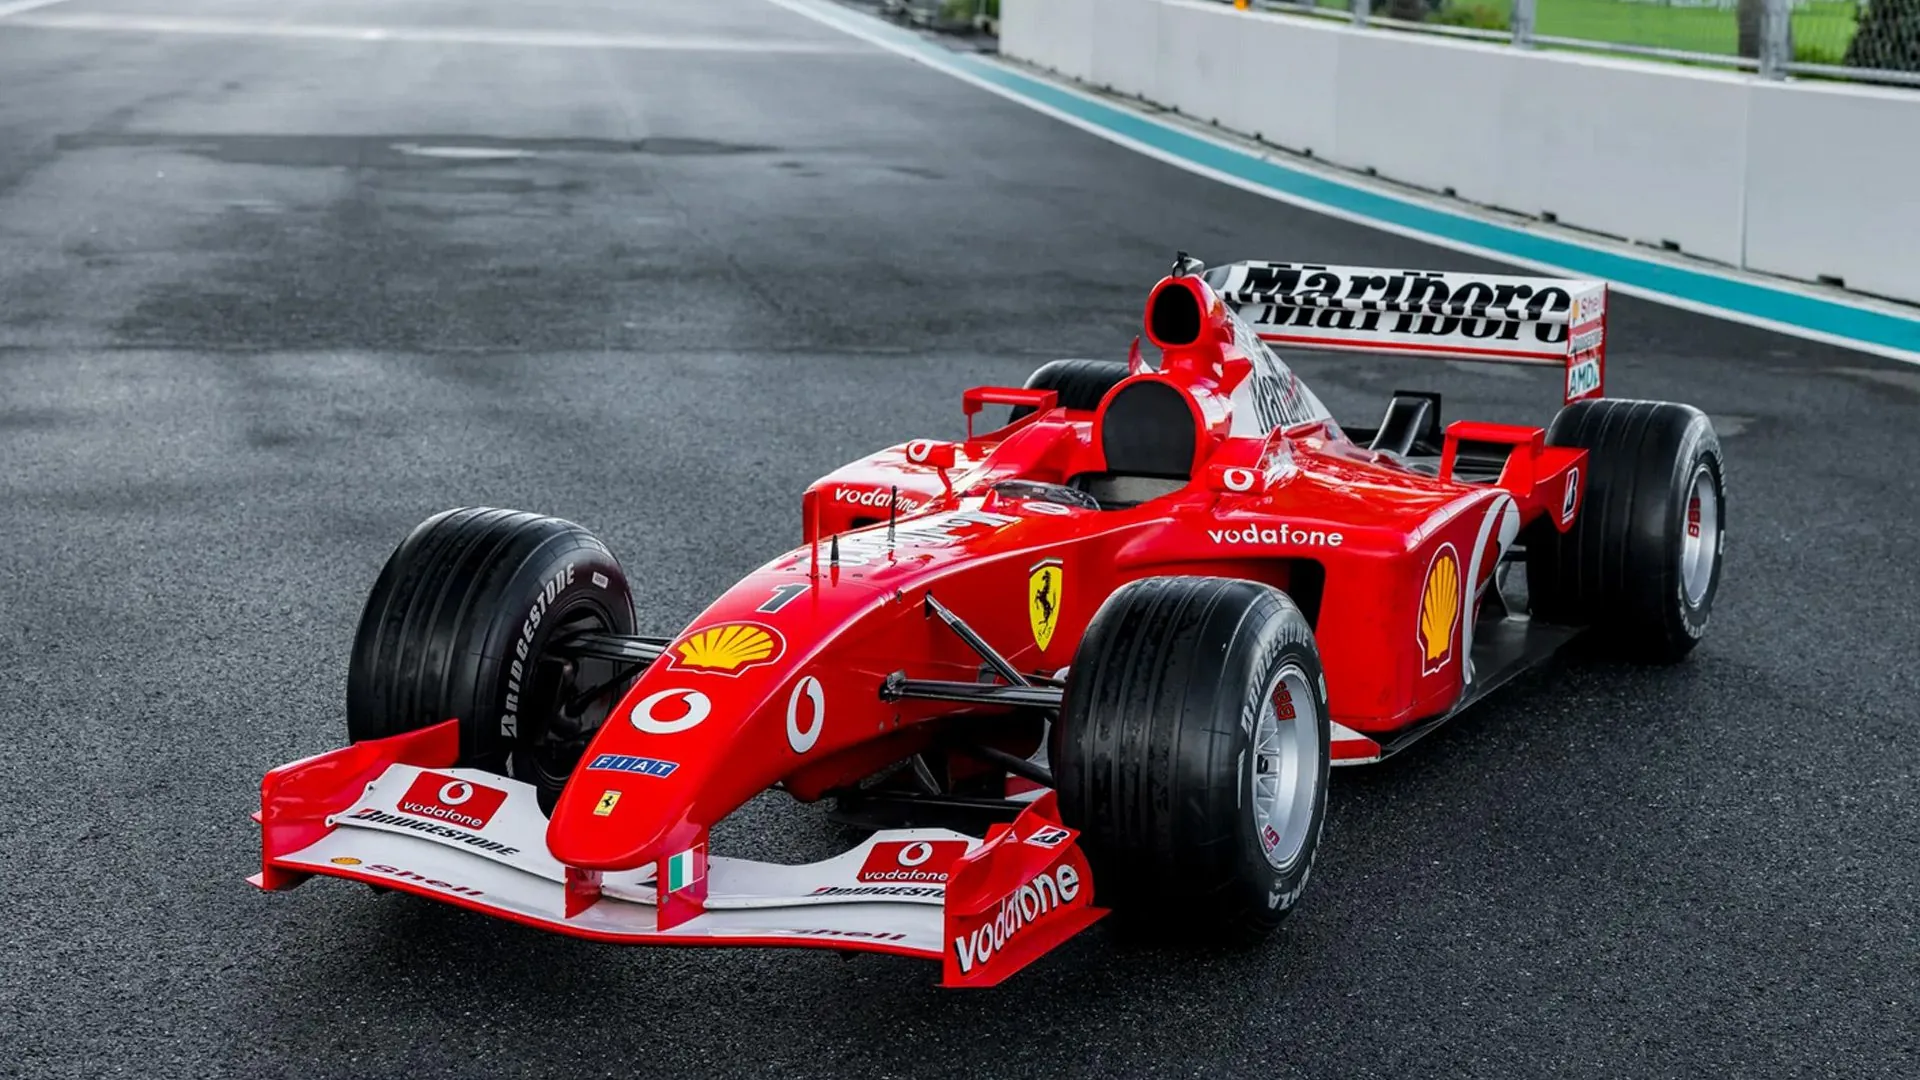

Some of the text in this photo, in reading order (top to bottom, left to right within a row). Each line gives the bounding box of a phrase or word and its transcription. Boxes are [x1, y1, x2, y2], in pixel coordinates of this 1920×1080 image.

[1238, 264, 1571, 321] Marlboro
[1208, 523, 1344, 546] vodafone
[756, 583, 812, 613] 1
[501, 562, 575, 738] BRIDGESTONE
[594, 757, 672, 774] FIAT
[403, 801, 483, 827] vodafone
[347, 808, 520, 856] BRIDGESTONE
[365, 864, 484, 896] Shell
[864, 869, 949, 881] vodafone
[954, 864, 1080, 973] vodafone
